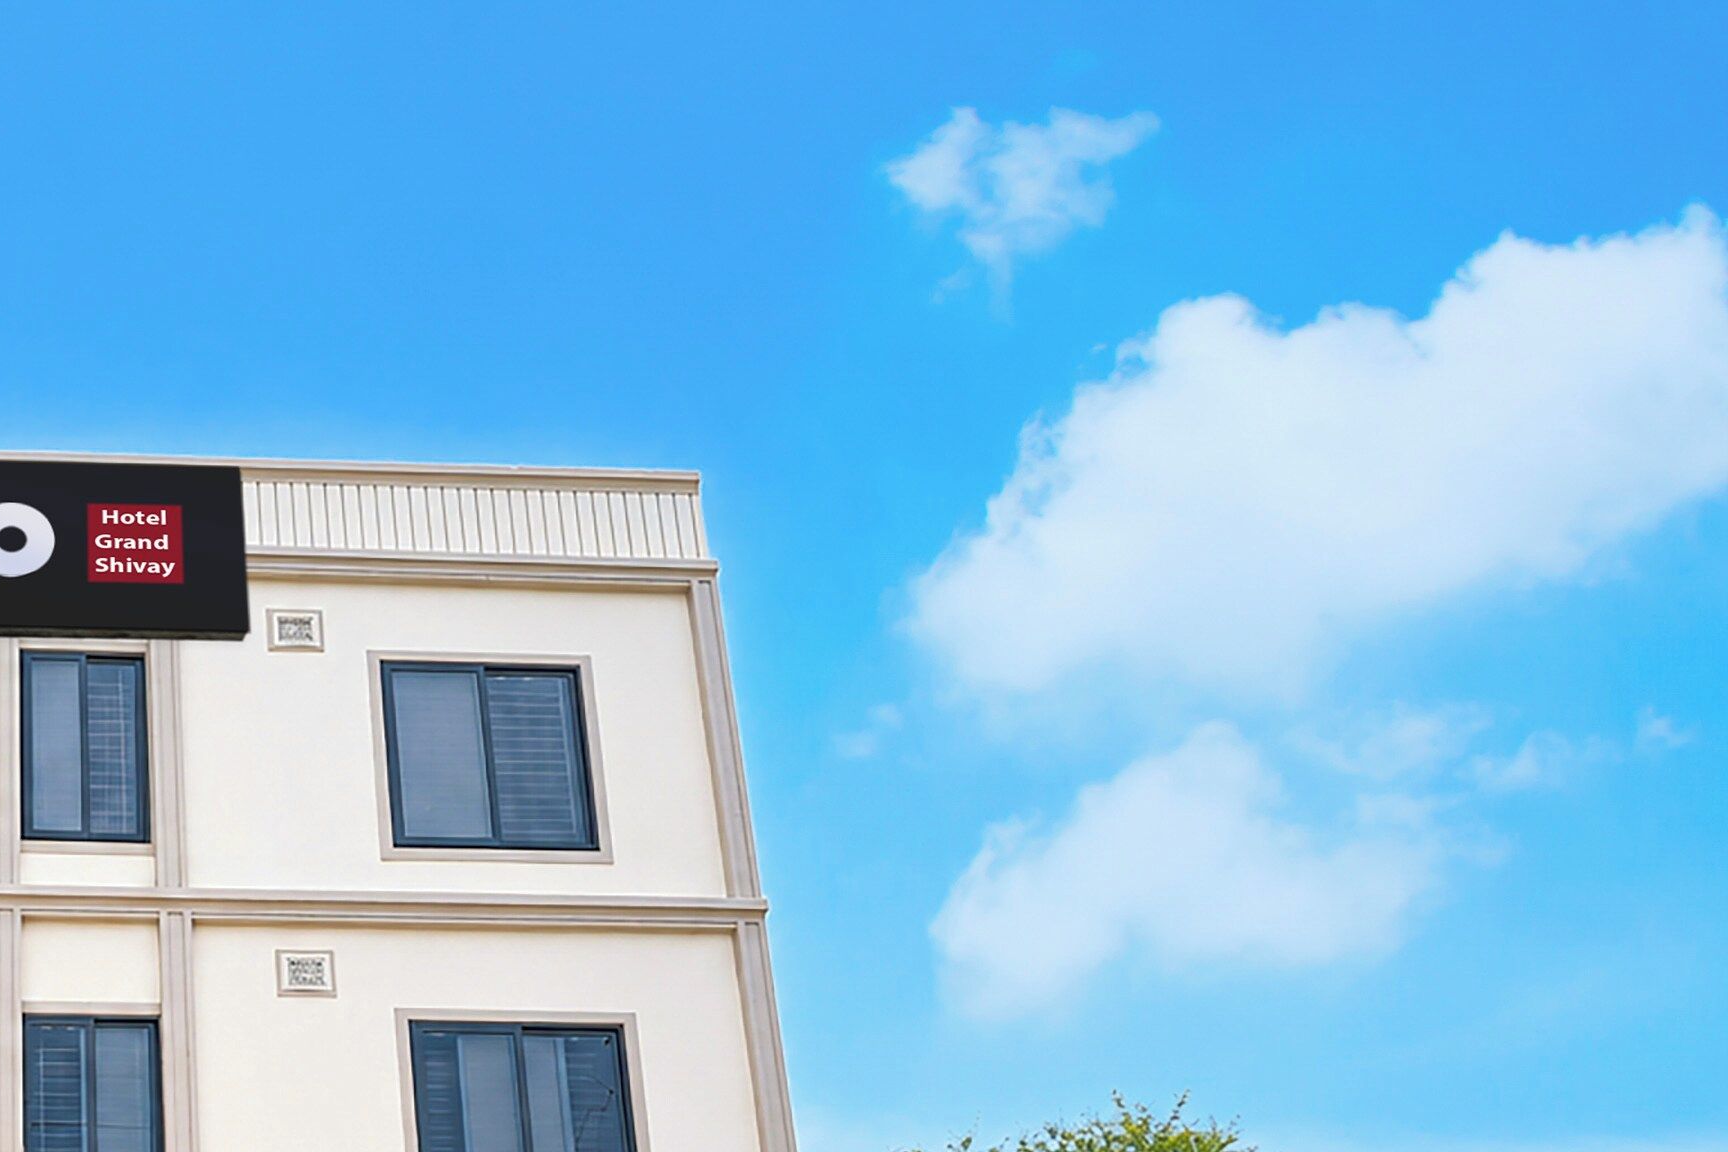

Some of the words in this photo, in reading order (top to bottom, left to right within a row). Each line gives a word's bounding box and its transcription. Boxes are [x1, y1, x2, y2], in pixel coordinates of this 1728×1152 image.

[101, 509, 167, 525] Hotel
[94, 533, 169, 550] Grand
[95, 556, 176, 578] Shivay
